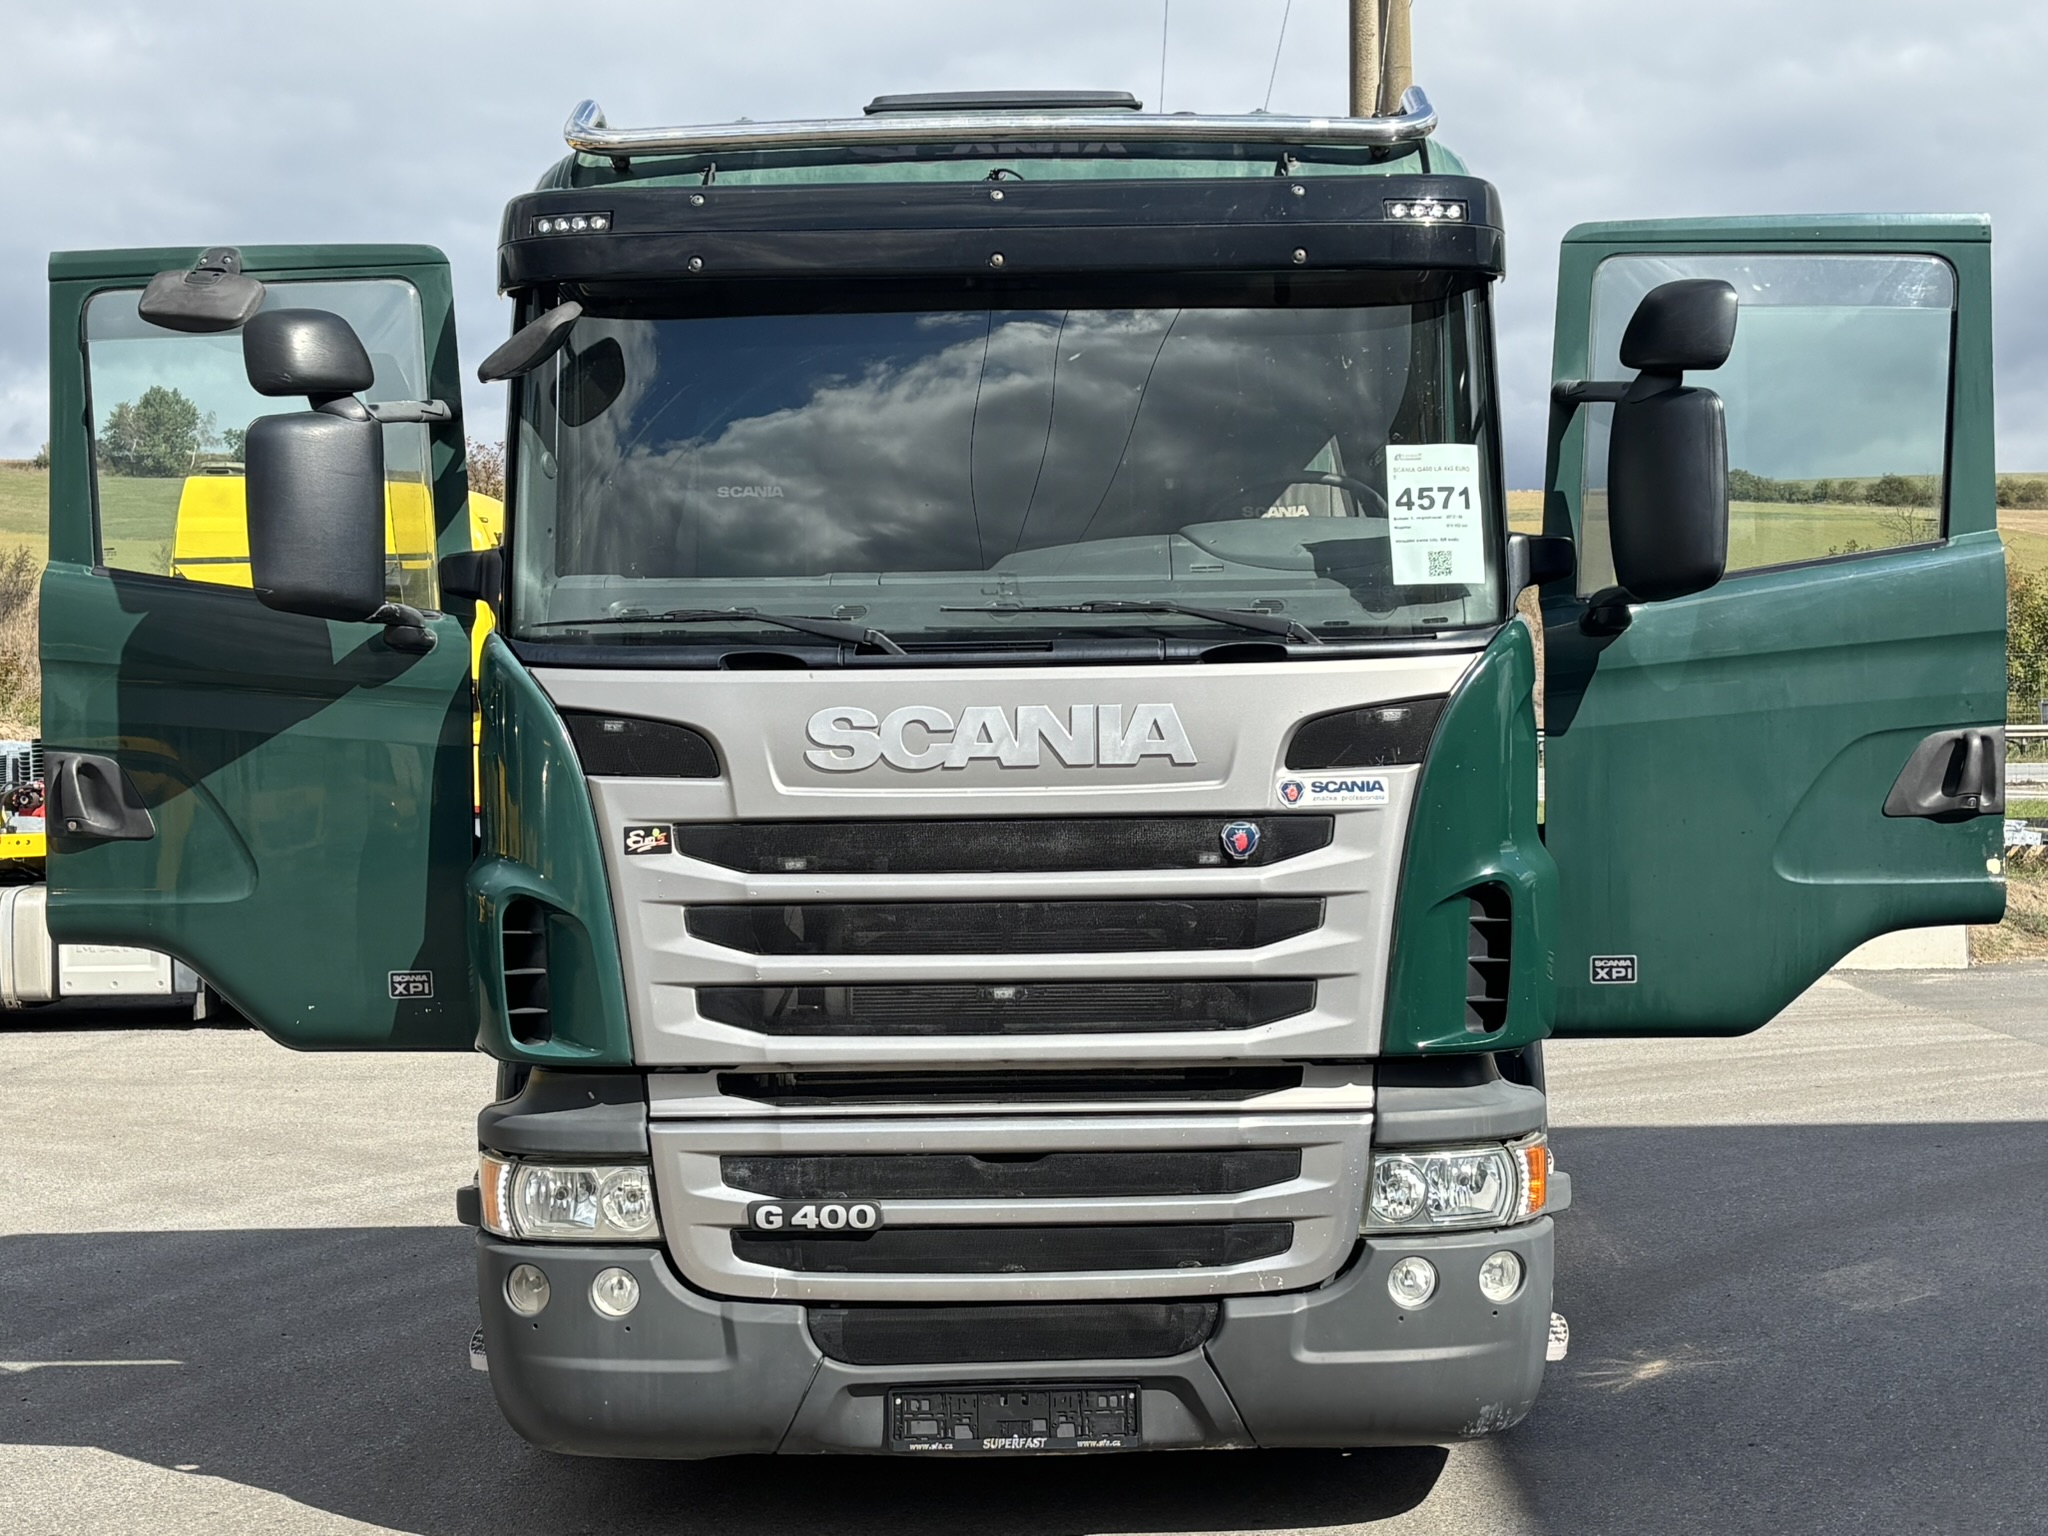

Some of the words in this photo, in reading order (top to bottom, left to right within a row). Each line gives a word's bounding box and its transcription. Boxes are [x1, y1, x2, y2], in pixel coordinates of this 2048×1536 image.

[717, 486, 784, 498] SCANIA
[1395, 486, 1471, 511] 4571
[1241, 504, 1310, 518] SCANIA
[804, 702, 1199, 773] SCANIA
[1311, 780, 1385, 793] SCANIA
[1594, 967, 1633, 980] XPI
[393, 982, 429, 995] XPI
[755, 1204, 784, 1230] G
[791, 1204, 877, 1230] 400
[982, 1437, 1048, 1450] SUPERFAST
